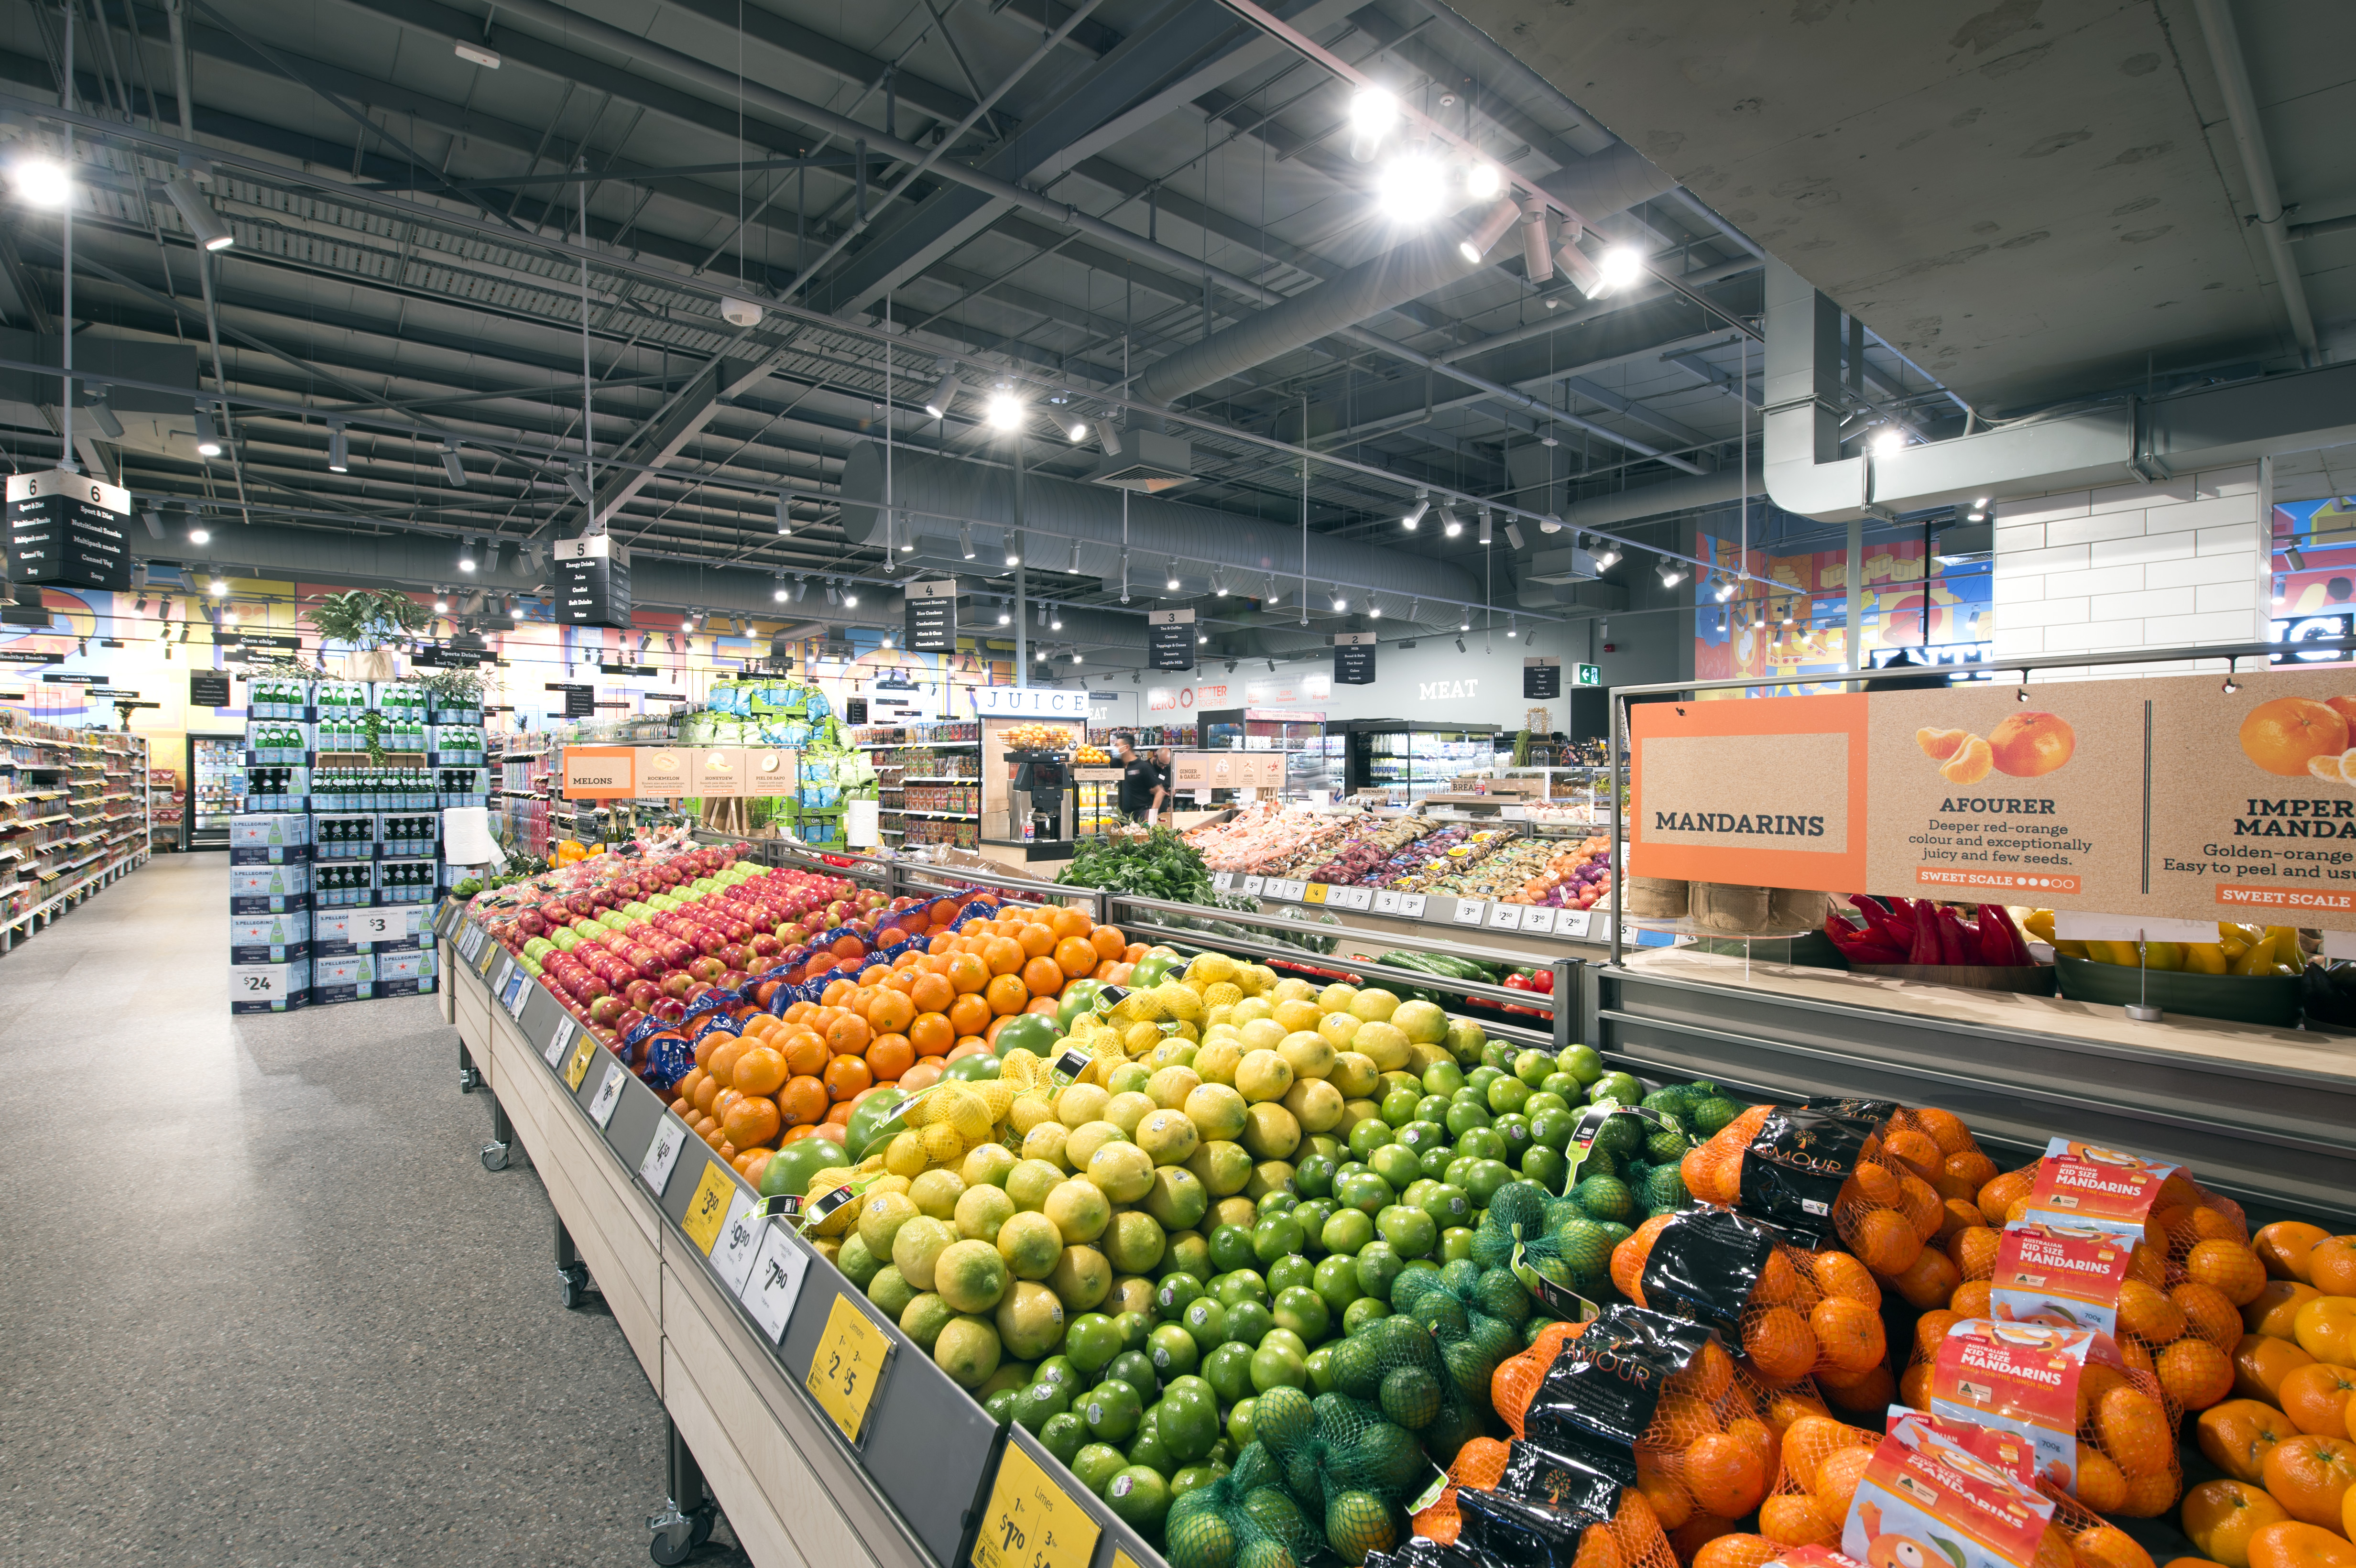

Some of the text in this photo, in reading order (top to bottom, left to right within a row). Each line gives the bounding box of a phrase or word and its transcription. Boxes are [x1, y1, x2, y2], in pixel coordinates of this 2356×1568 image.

[29, 479, 37, 495] 6
[91, 486, 100, 502] 6
[80, 505, 96, 515] Sport
[101, 512, 114, 521] Diet
[71, 519, 122, 538] Nutritional Snacks
[74, 535, 120, 553] Multipack snacks
[577, 543, 585, 556] 5
[81, 554, 113, 568] Canned Veg
[617, 547, 620, 560] 5
[91, 572, 104, 581] Soup
[926, 585, 933, 596] 4
[1168, 613, 1175, 622] 3
[1198, 686, 1227, 697] BETTER
[1419, 679, 1478, 700] MEAT
[988, 692, 1083, 710] JUICE
[1198, 698, 1227, 707] TOGETHER
[1940, 798, 2055, 814] AFOURER
[1655, 812, 1824, 836] MANDARINS
[1929, 819, 2068, 837] Deeper red-orange
[1909, 835, 2093, 853] colour and exceptionally
[1922, 848, 2072, 865] juicy and few seeds.
[2203, 843, 2353, 865] Golden-orange
[2163, 859, 2207, 875] Easy
[2211, 862, 2231, 873] to
[2236, 863, 2277, 877] peel
[2283, 866, 2321, 878] and
[1921, 871, 2013, 886] SWEET SCALE
[2222, 889, 2351, 907] SWEET SCALE
[370, 919, 386, 931] $3
[244, 976, 271, 991] $24
[1113, 986, 1126, 997] LEMONS
[1067, 1055, 1083, 1067] LEMONS
[1754, 1145, 1842, 1174] AMOUR
[2061, 1164, 2097, 1173] AUSTRALIAN
[2079, 1170, 2098, 1179] SIZE
[2055, 1175, 2141, 1196] MANDARINS
[2019, 1250, 2110, 1274] MANDARINS
[2084, 1312, 2101, 1323] 700g
[849, 1318, 865, 1340] Lemons
[829, 1350, 840, 1380] $2
[1560, 1341, 1650, 1392] AMOUR
[1961, 1353, 2062, 1385] MANDARINS
[844, 1366, 857, 1396] $5
[1034, 1485, 1054, 1512] Limes
[1906, 1458, 2023, 1529] MANDARINS
[1015, 1498, 1021, 1512] 1
[1045, 1531, 1052, 1546] 3
